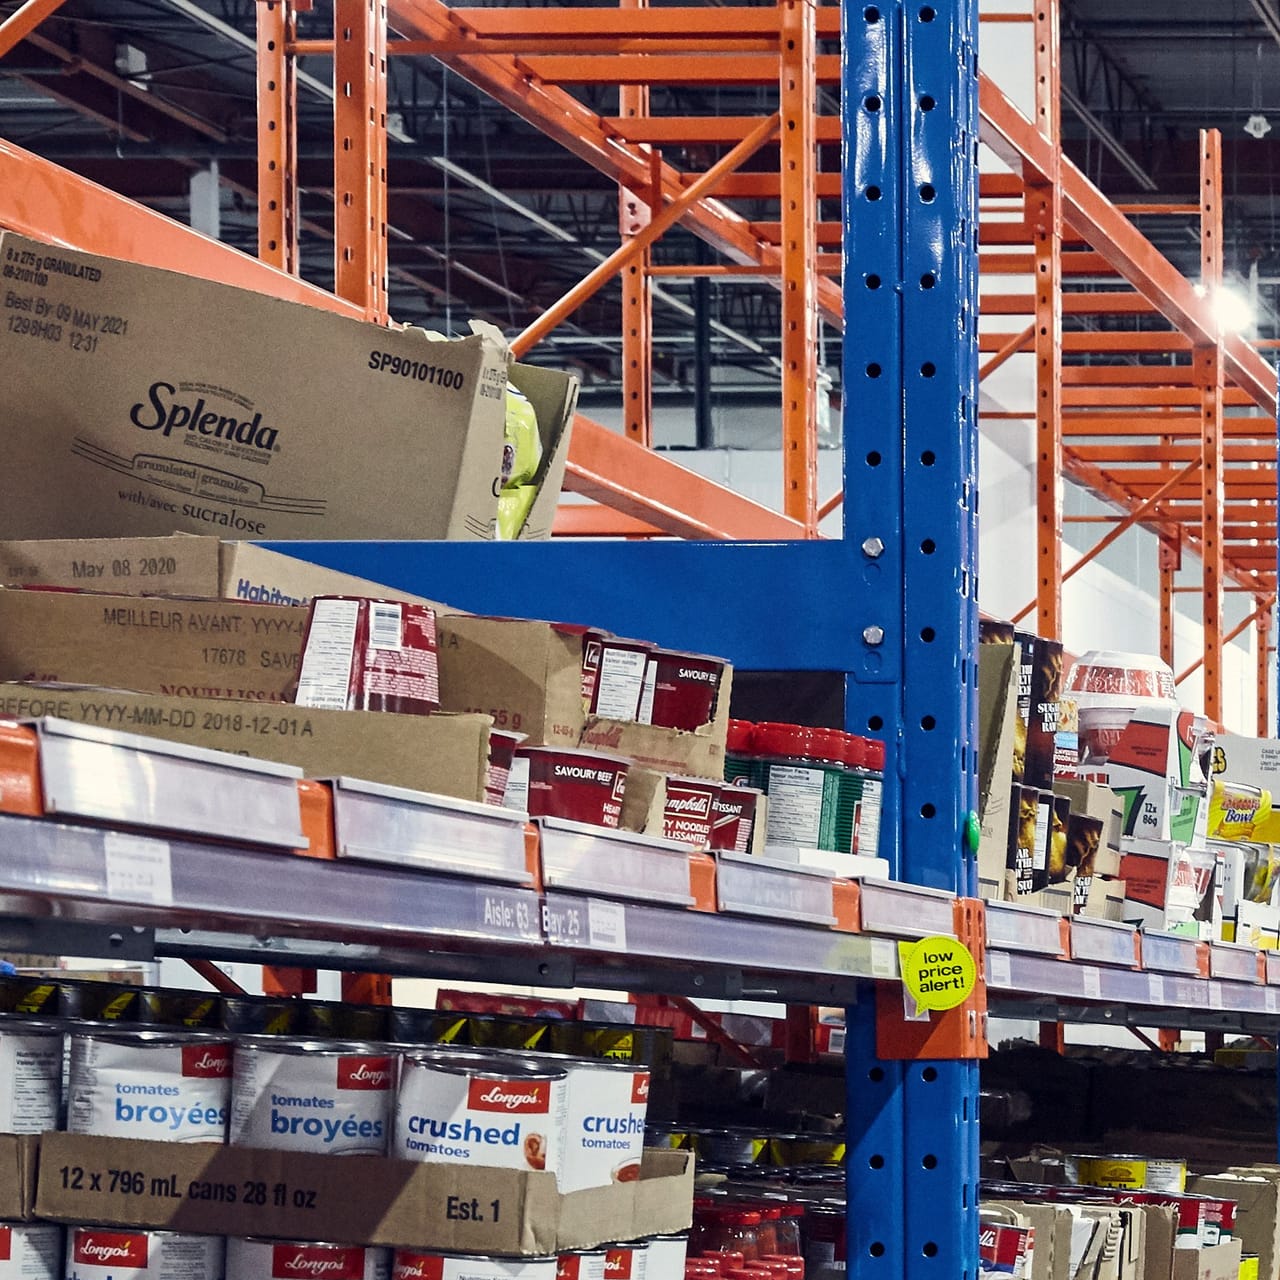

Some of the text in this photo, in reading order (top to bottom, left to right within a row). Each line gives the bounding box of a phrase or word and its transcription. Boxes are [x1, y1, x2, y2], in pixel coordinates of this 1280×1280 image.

[43, 258, 102, 282] GRANULATED
[5, 292, 129, 335] Best 09 MAY 2021
[368, 351, 464, 390] SP90101100
[130, 381, 280, 450] Splenda
[136, 459, 197, 481] granulated
[118, 490, 178, 514] with/avec
[182, 502, 266, 535] sucralose
[72, 558, 176, 579] May 08 2020
[103, 608, 183, 629] MEILLEUR
[202, 649, 246, 665] 17678
[678, 668, 709, 681] SAVOURY
[80, 704, 196, 729] YYYY-MM-DD
[555, 765, 613, 782] SAVOURY BEEF
[1226, 810, 1255, 822] Bowl
[676, 821, 711, 834] NOODLES
[485, 898, 580, 936] Aisle: 63 Bay: 25
[924, 952, 953, 964] low
[919, 965, 963, 981] price
[919, 977, 965, 993] alert!
[115, 1083, 180, 1097] tomates
[480, 1087, 540, 1107] Longo's
[271, 1094, 334, 1109] tomates
[271, 1110, 383, 1143] broyées
[409, 1113, 520, 1146] crushed
[583, 1112, 646, 1135] crushe
[406, 1138, 470, 1158] tomatoes
[582, 1138, 631, 1151] tomatoes
[60, 1166, 500, 1222] 12 x 796 mL cans 28 fl oz Est. 1
[80, 1241, 130, 1261] Longo's
[286, 1255, 344, 1273] Longo's
